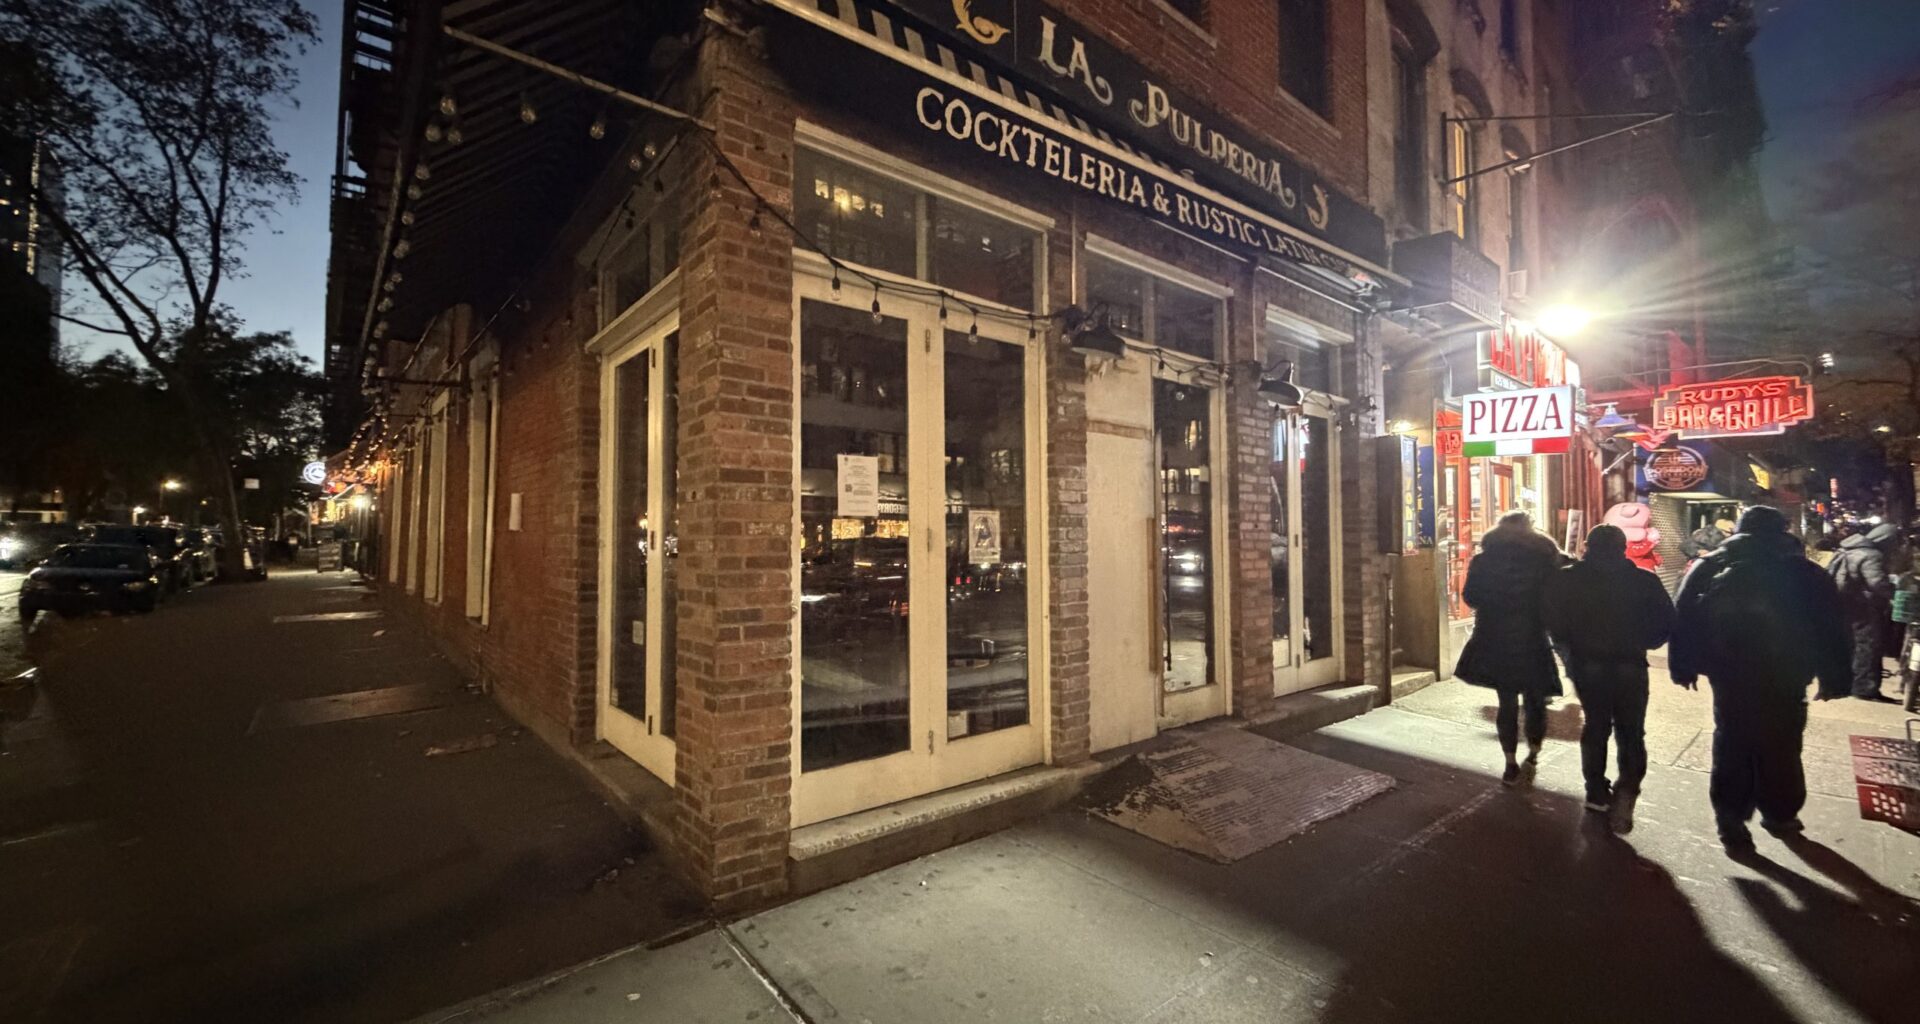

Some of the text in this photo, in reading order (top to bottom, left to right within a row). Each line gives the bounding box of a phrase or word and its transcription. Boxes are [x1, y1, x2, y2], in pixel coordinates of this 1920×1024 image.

[1039, 15, 1296, 208] LA PULPERIA
[915, 86, 1148, 205] COCKTELERIA
[1152, 182, 1172, 217] &
[1175, 192, 1261, 248] RUSTIC
[1262, 228, 1321, 265] LATIN
[1468, 392, 1564, 436] PIZZA
[1676, 381, 1789, 405] RUDY'S
